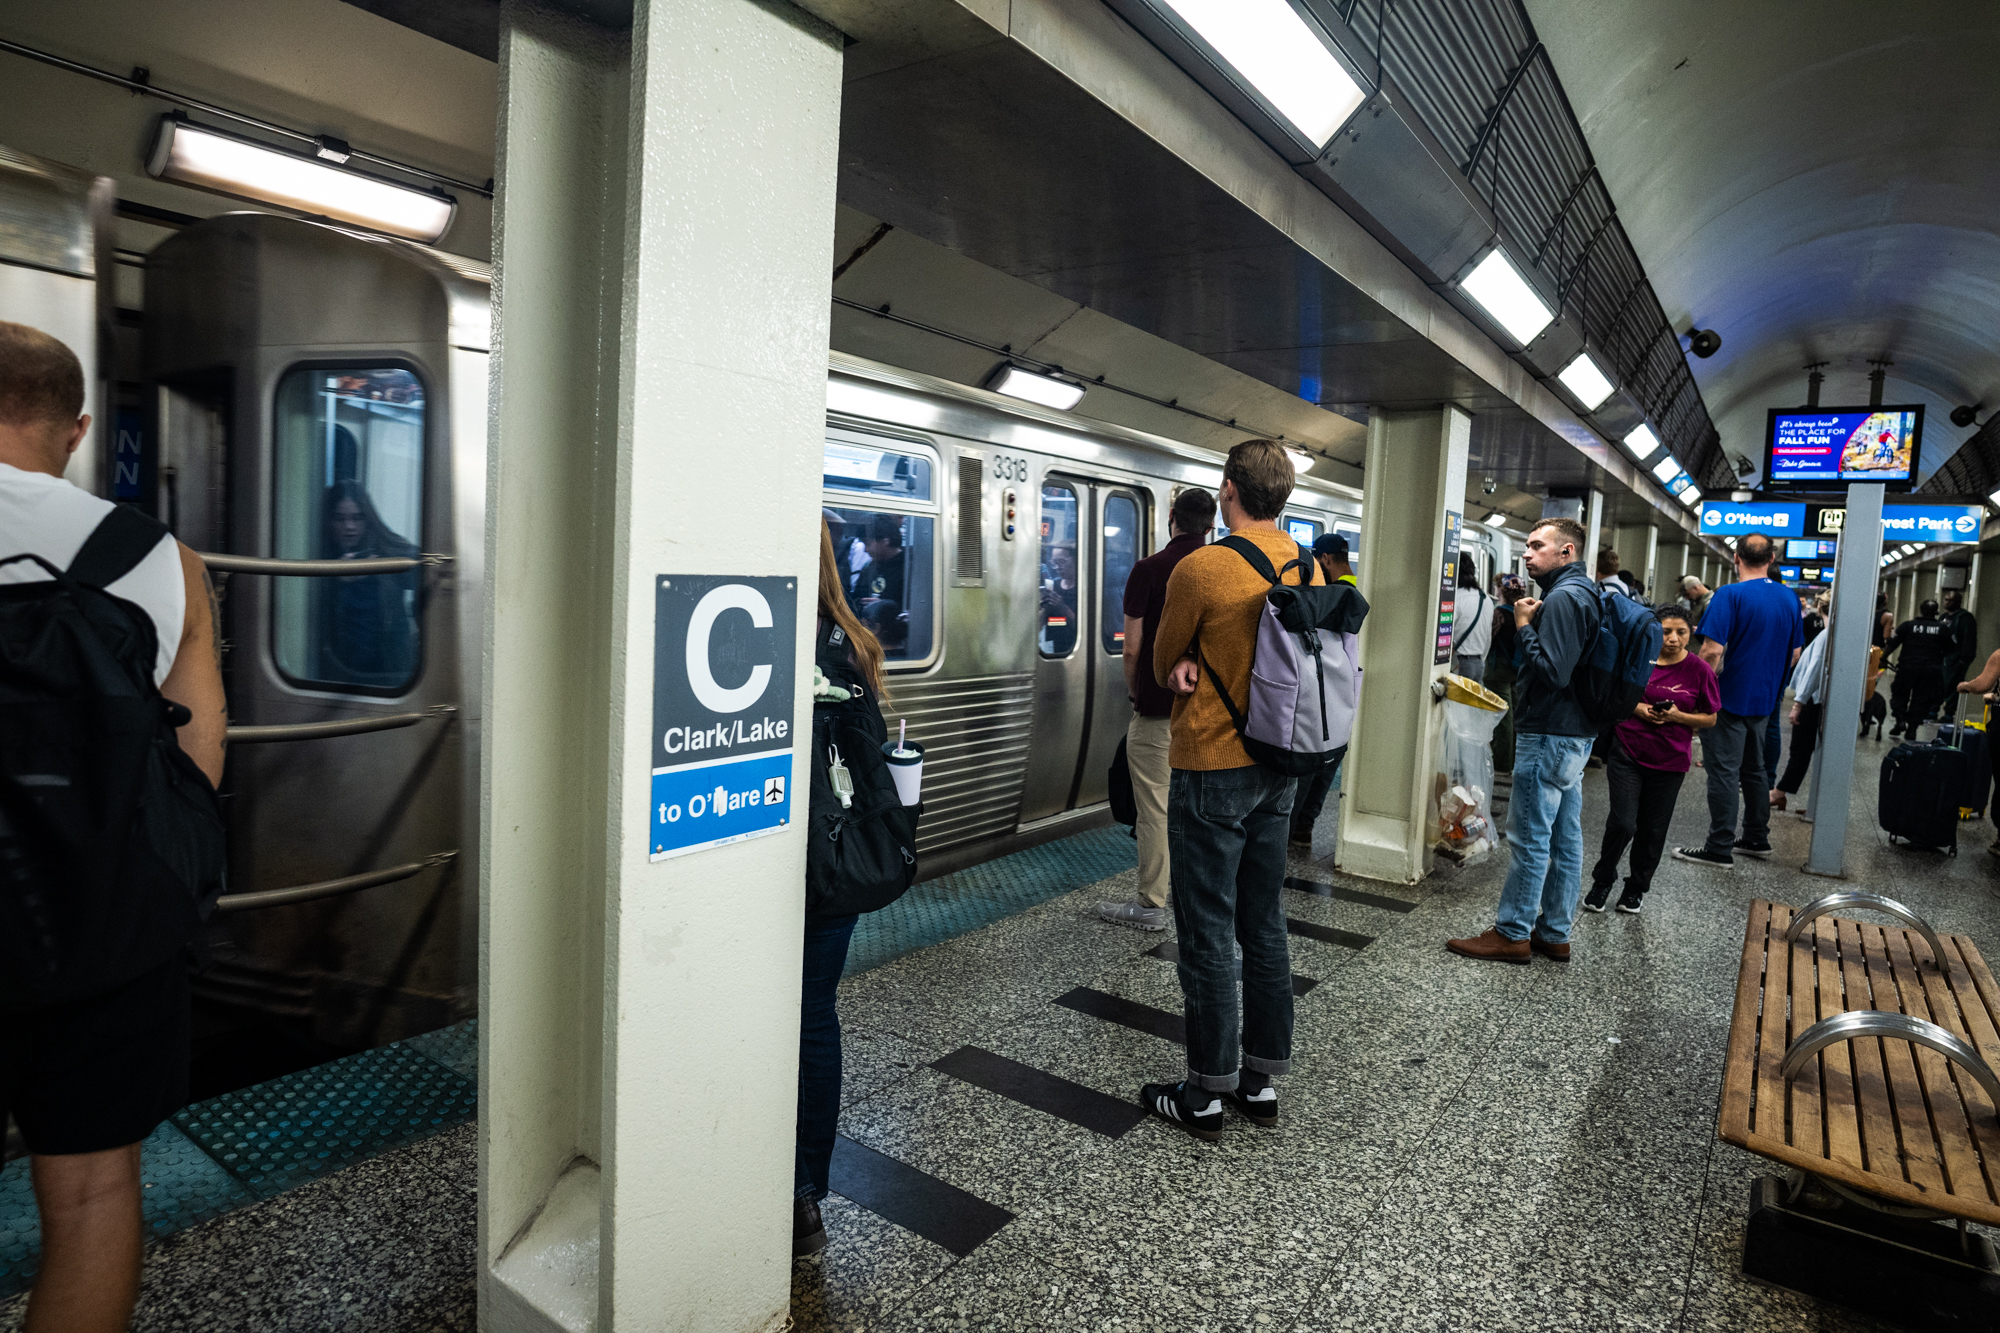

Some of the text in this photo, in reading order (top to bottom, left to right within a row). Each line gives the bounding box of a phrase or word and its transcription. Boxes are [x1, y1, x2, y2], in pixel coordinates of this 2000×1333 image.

[1778, 436, 1831, 445] FALL FUN
[1780, 428, 1846, 437] THE PLACE FOR
[993, 454, 1028, 483] 3318
[1724, 512, 1773, 526] O'Hare
[1918, 517, 1954, 530] Park
[685, 583, 774, 713] C
[663, 716, 789, 754] Clark/Lake
[658, 802, 682, 824] to
